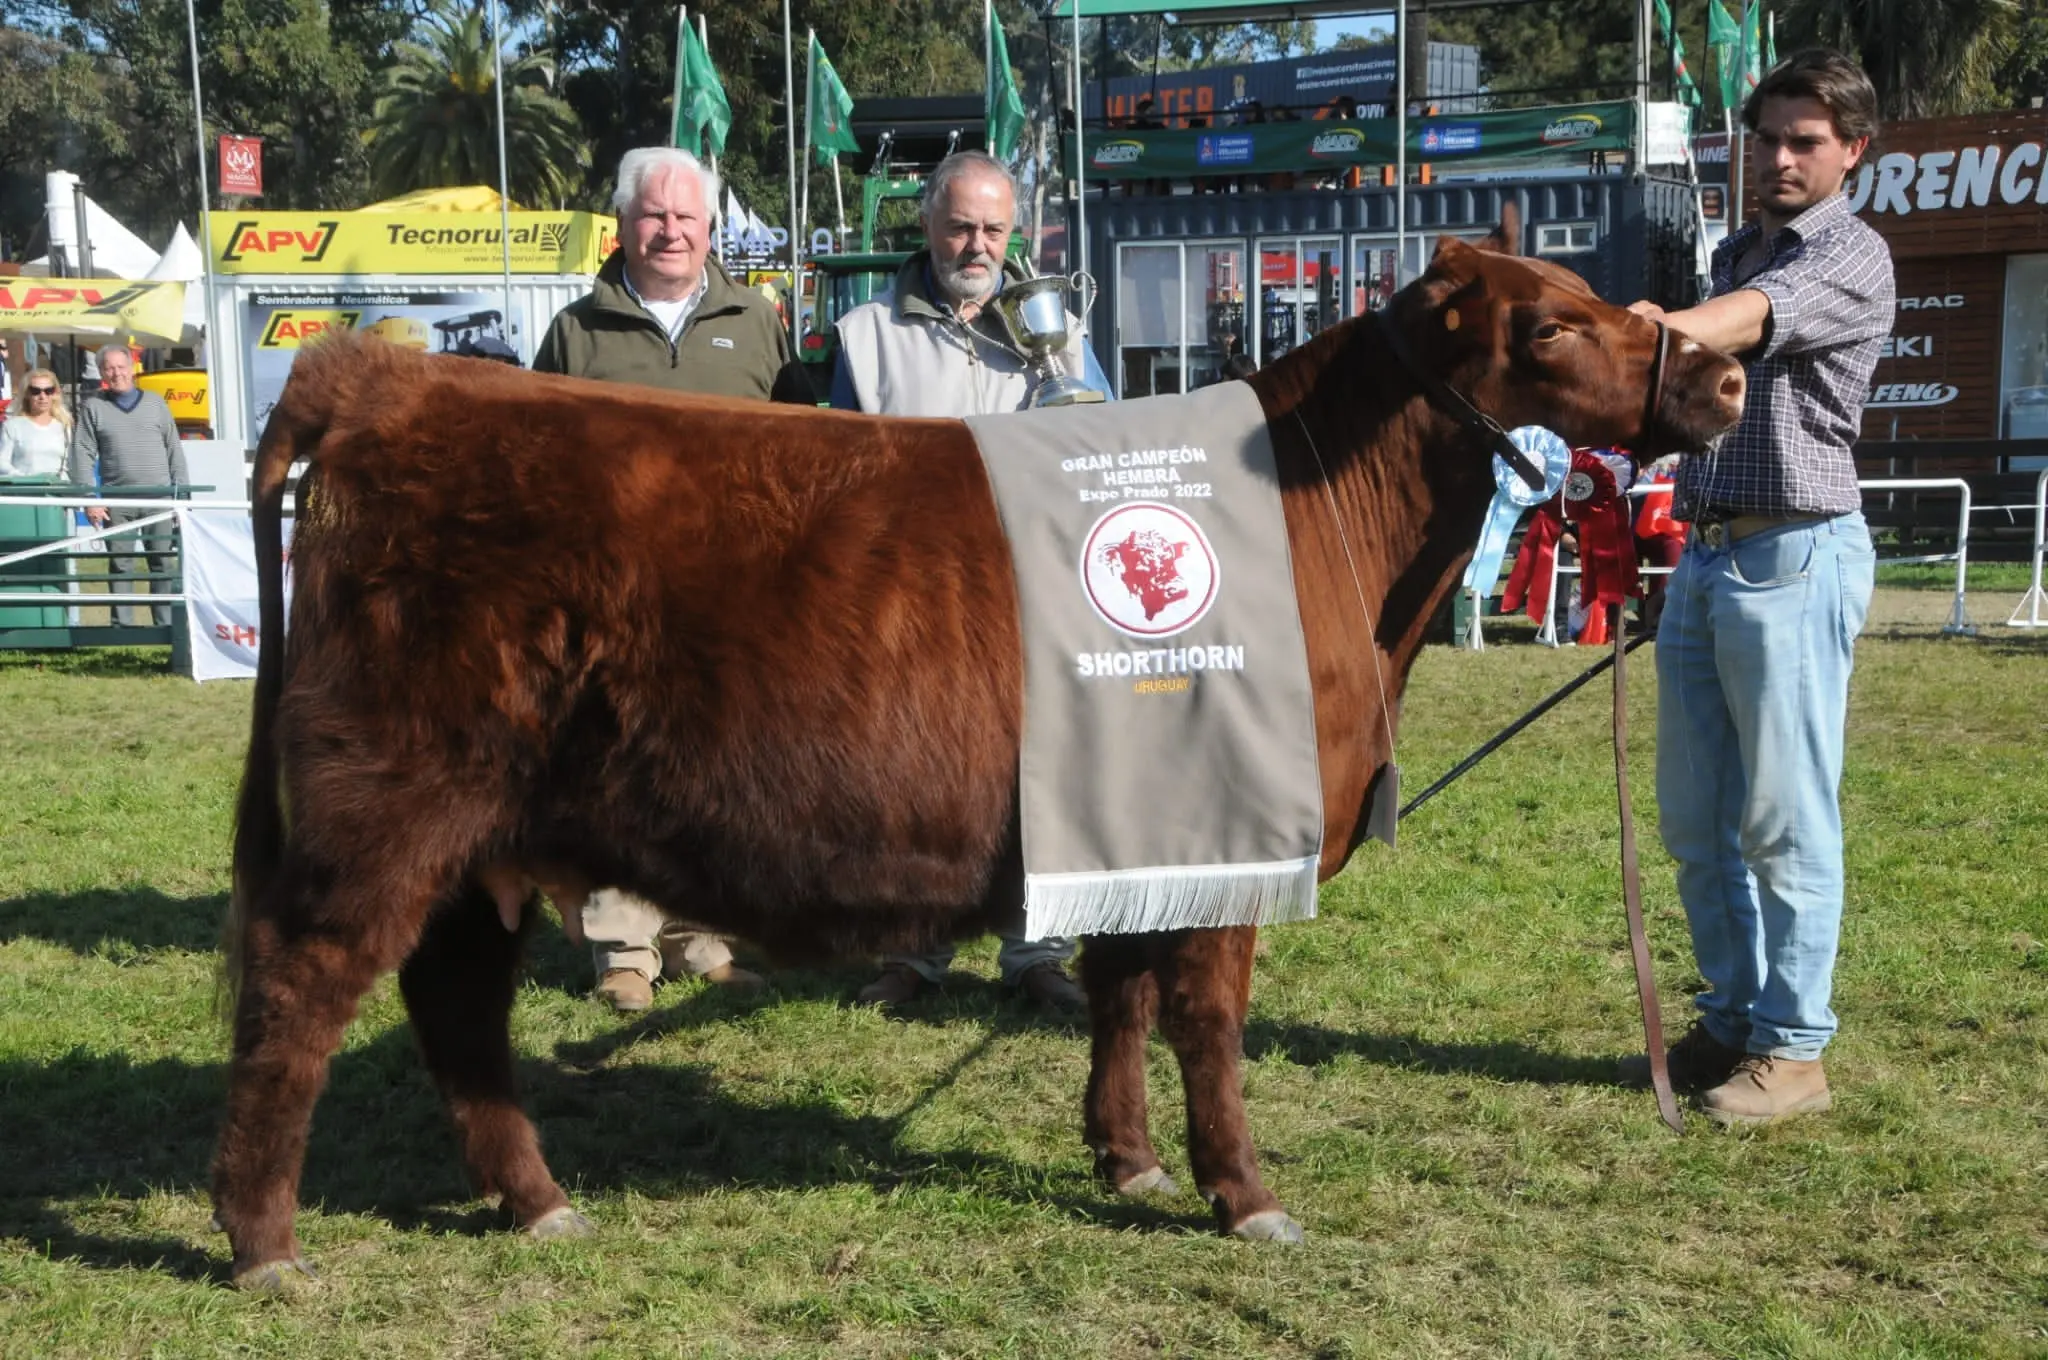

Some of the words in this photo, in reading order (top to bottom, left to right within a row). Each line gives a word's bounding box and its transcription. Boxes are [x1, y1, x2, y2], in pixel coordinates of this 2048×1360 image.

[238, 230, 325, 253] APV
[257, 295, 335, 305] Sembradoras
[341, 294, 410, 305] Neumáticas
[1060, 453, 1114, 473] GRAN
[1118, 445, 1208, 468] CAMPEÓN
[1102, 466, 1182, 487] HEMBRA
[1079, 488, 1120, 503] Expo
[1123, 485, 1169, 499] Prado
[1173, 482, 1213, 498] 2022
[1077, 645, 1245, 677] SHORTHORN
[1133, 676, 1190, 695] URUGUAY
